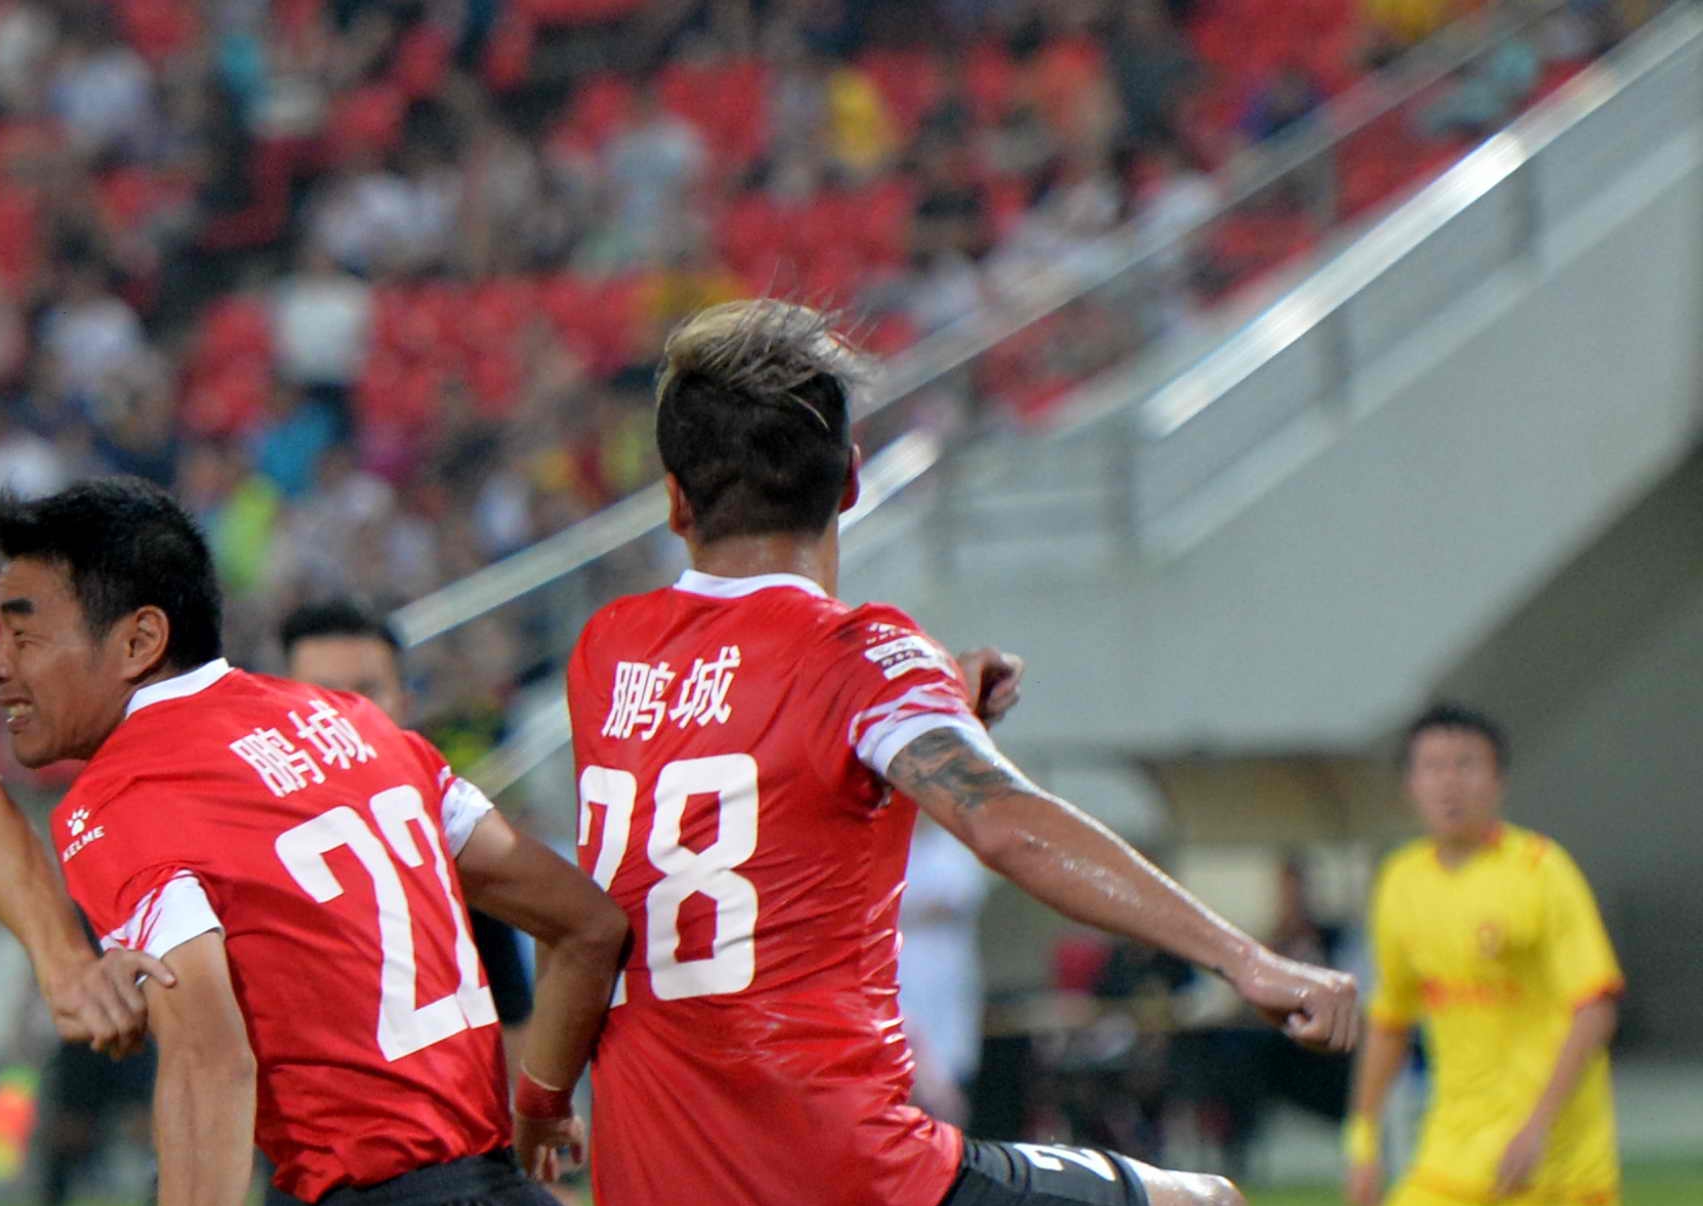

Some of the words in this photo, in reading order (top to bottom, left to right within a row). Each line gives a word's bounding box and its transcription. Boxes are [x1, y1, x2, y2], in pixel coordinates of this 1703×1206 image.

[601, 645, 741, 741] 鹏城
[229, 699, 378, 797] 鹏城
[63, 825, 105, 863] KELME
[579, 753, 759, 1008] 28
[275, 784, 499, 1063] 22
